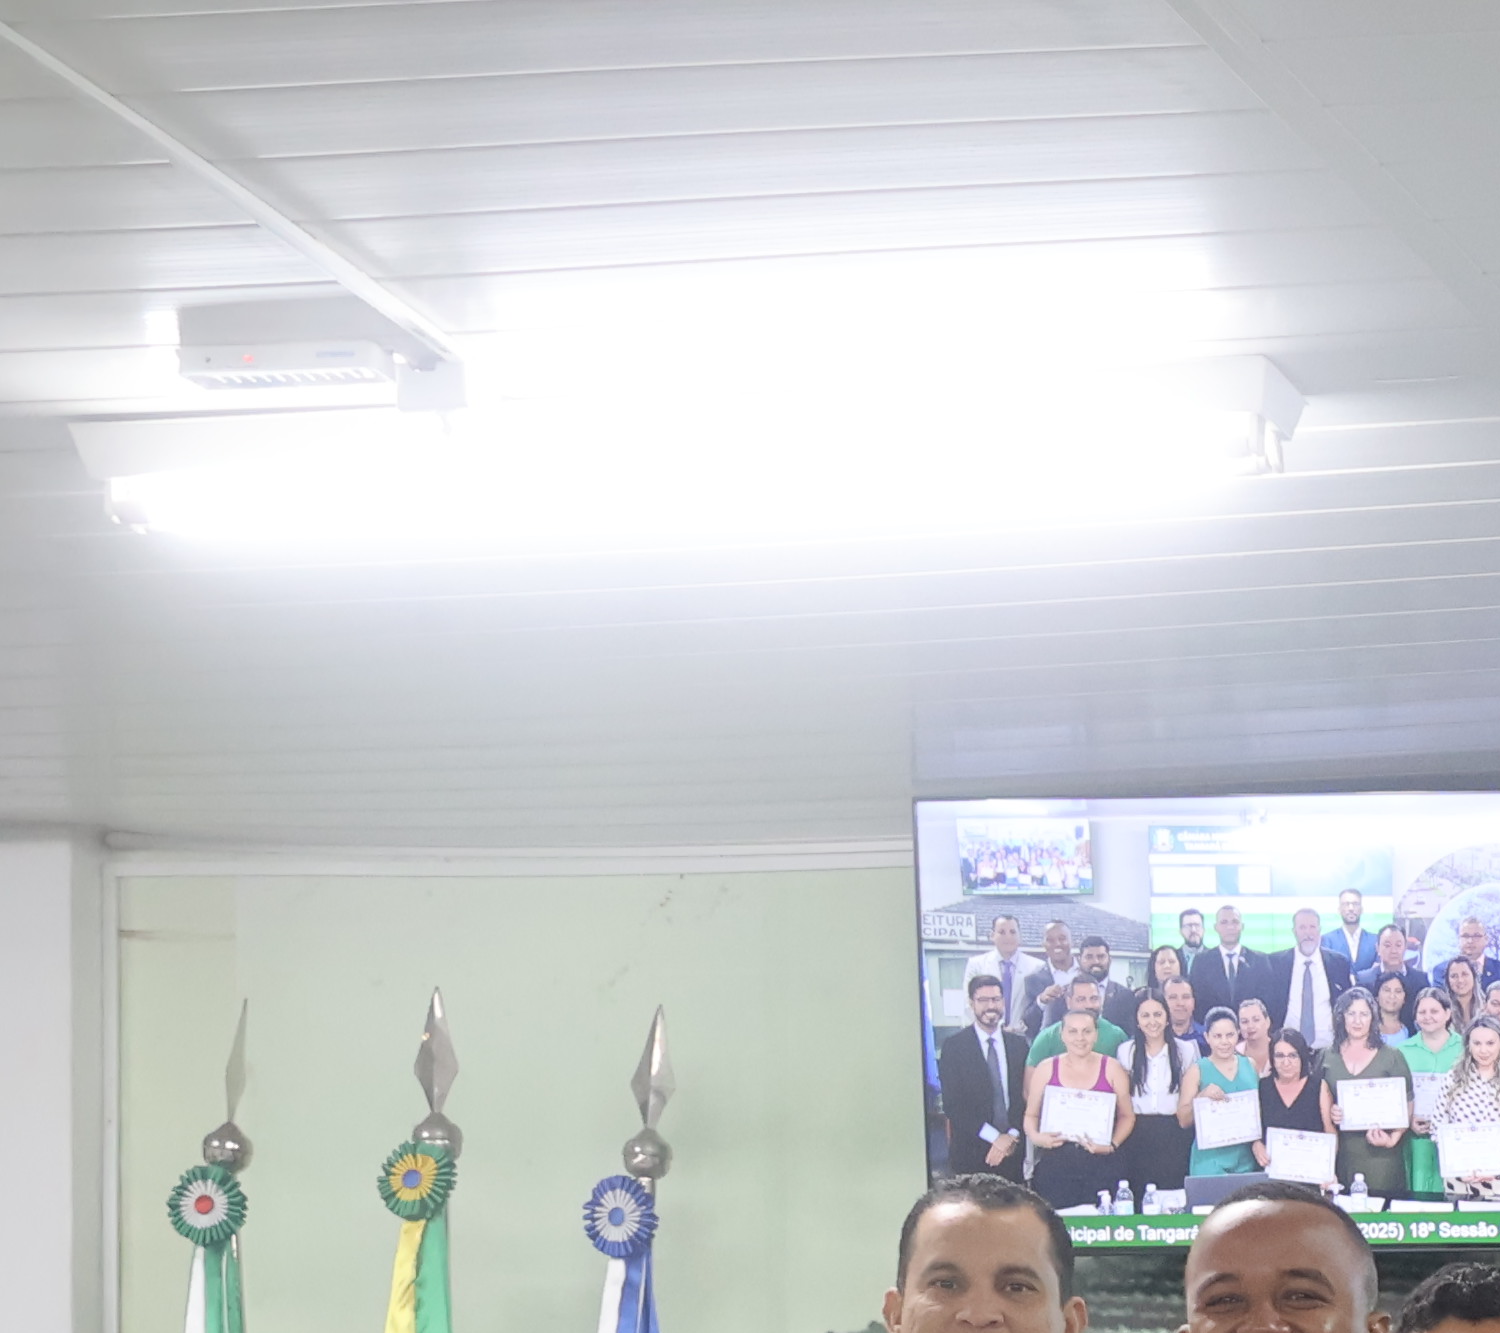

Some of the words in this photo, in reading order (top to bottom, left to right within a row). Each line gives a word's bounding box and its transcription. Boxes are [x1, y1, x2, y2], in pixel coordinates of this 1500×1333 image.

[1068, 1225, 1110, 1244] icipal
[1114, 1225, 1134, 1241] de
[1410, 1222, 1435, 1239] 18ª
[1439, 1221, 1498, 1239] Sessão
